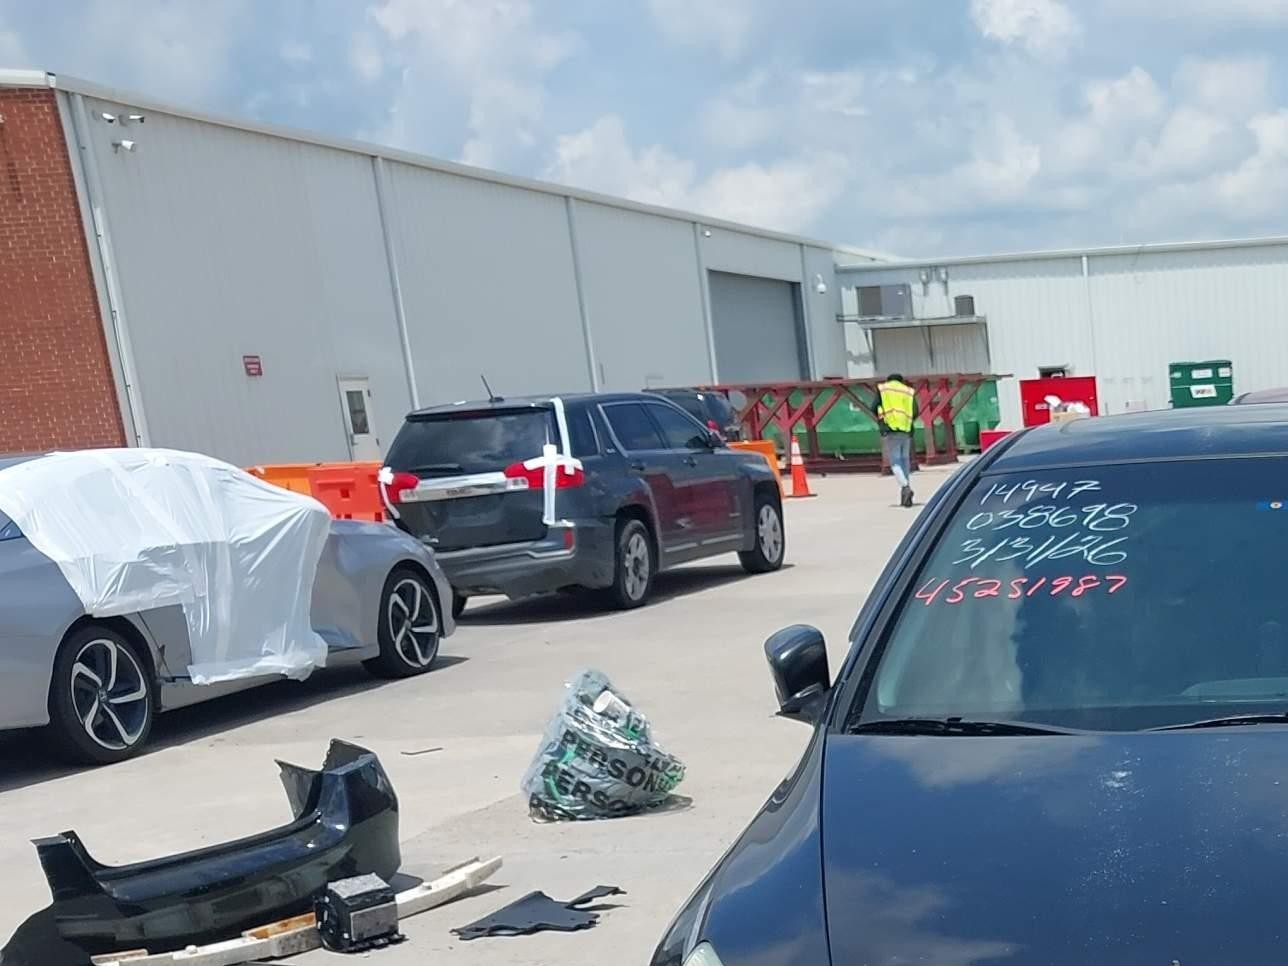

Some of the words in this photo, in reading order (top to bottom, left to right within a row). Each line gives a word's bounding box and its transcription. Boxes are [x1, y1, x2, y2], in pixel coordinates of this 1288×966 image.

[980, 479, 1102, 505] 14947
[966, 502, 1138, 532] 038698
[915, 575, 1128, 606] 45251987
